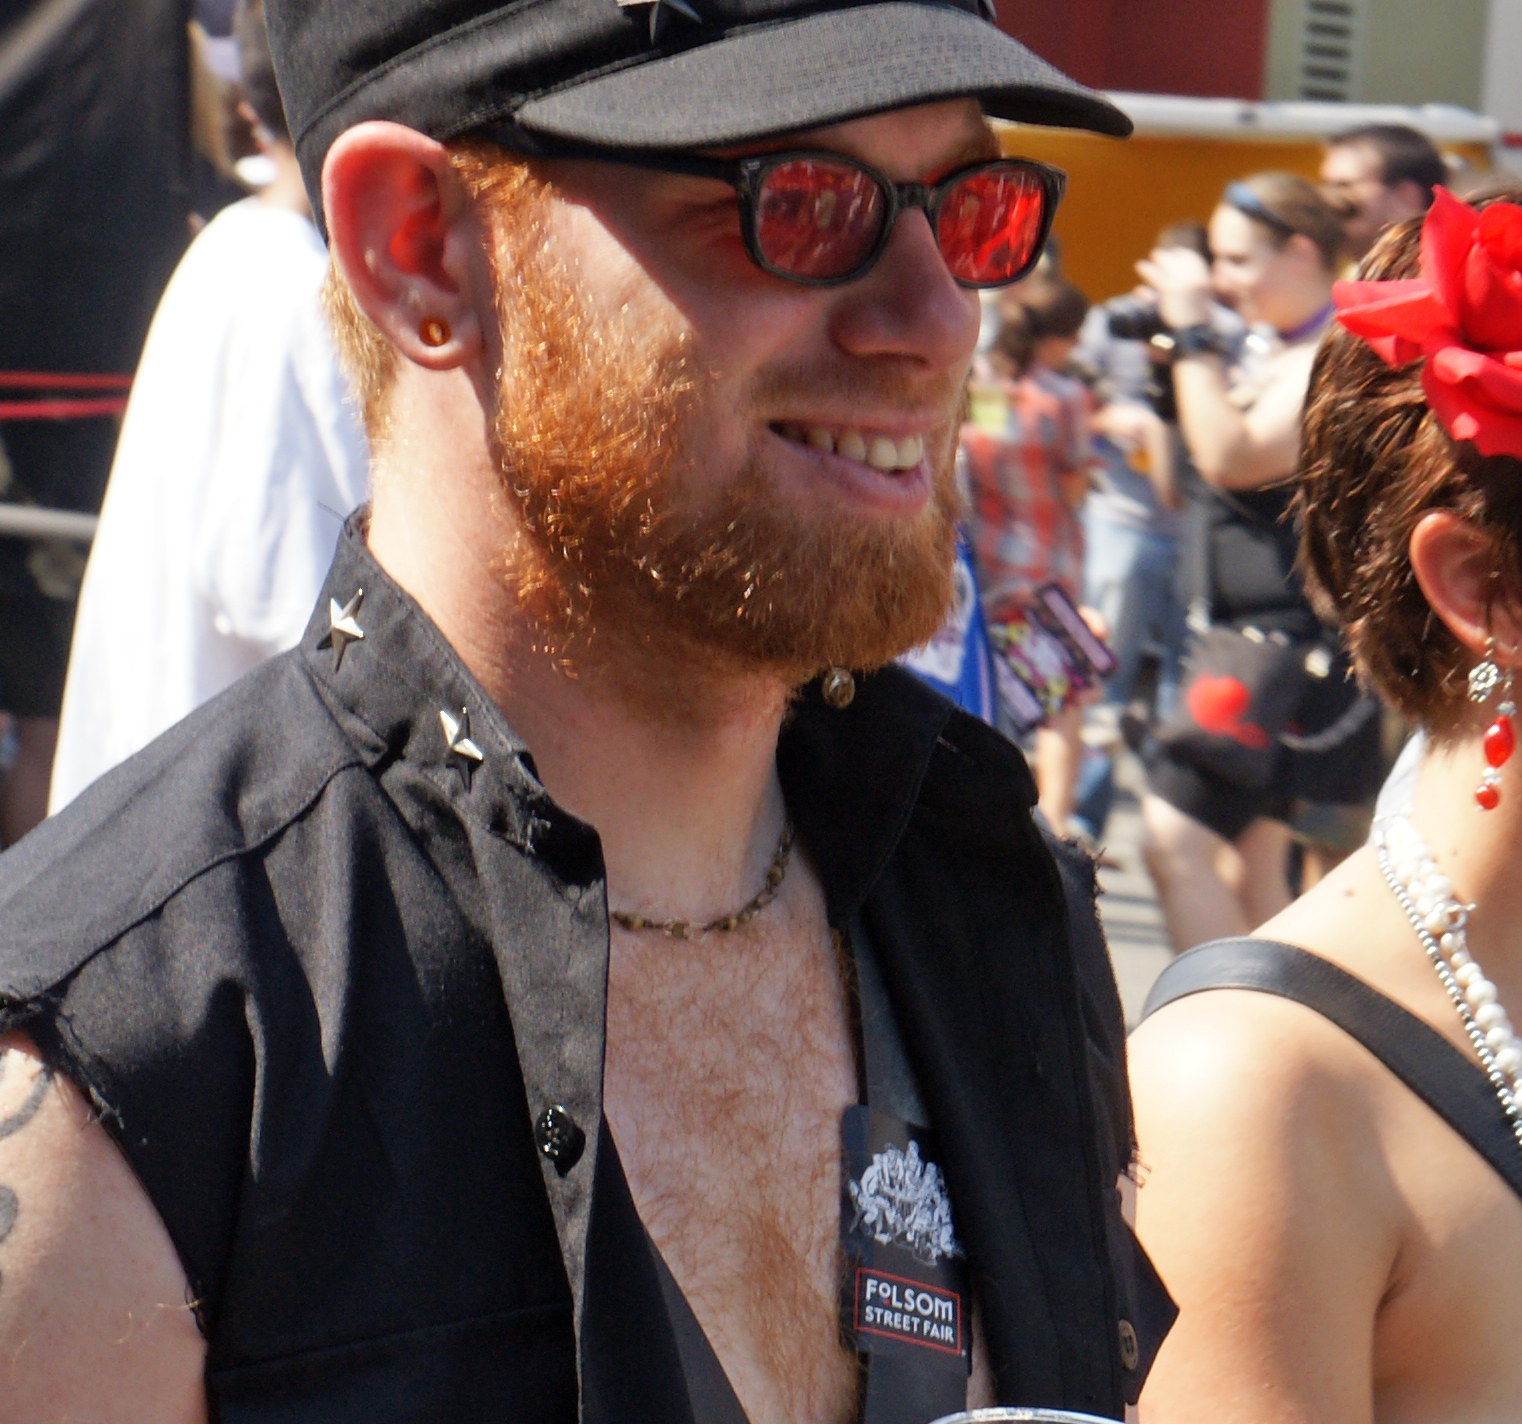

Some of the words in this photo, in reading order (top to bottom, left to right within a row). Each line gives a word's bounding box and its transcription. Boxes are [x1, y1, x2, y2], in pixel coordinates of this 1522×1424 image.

[866, 1278, 953, 1322] FOLSOM
[864, 1305, 921, 1334] STREET
[923, 1319, 954, 1343] FAIR
